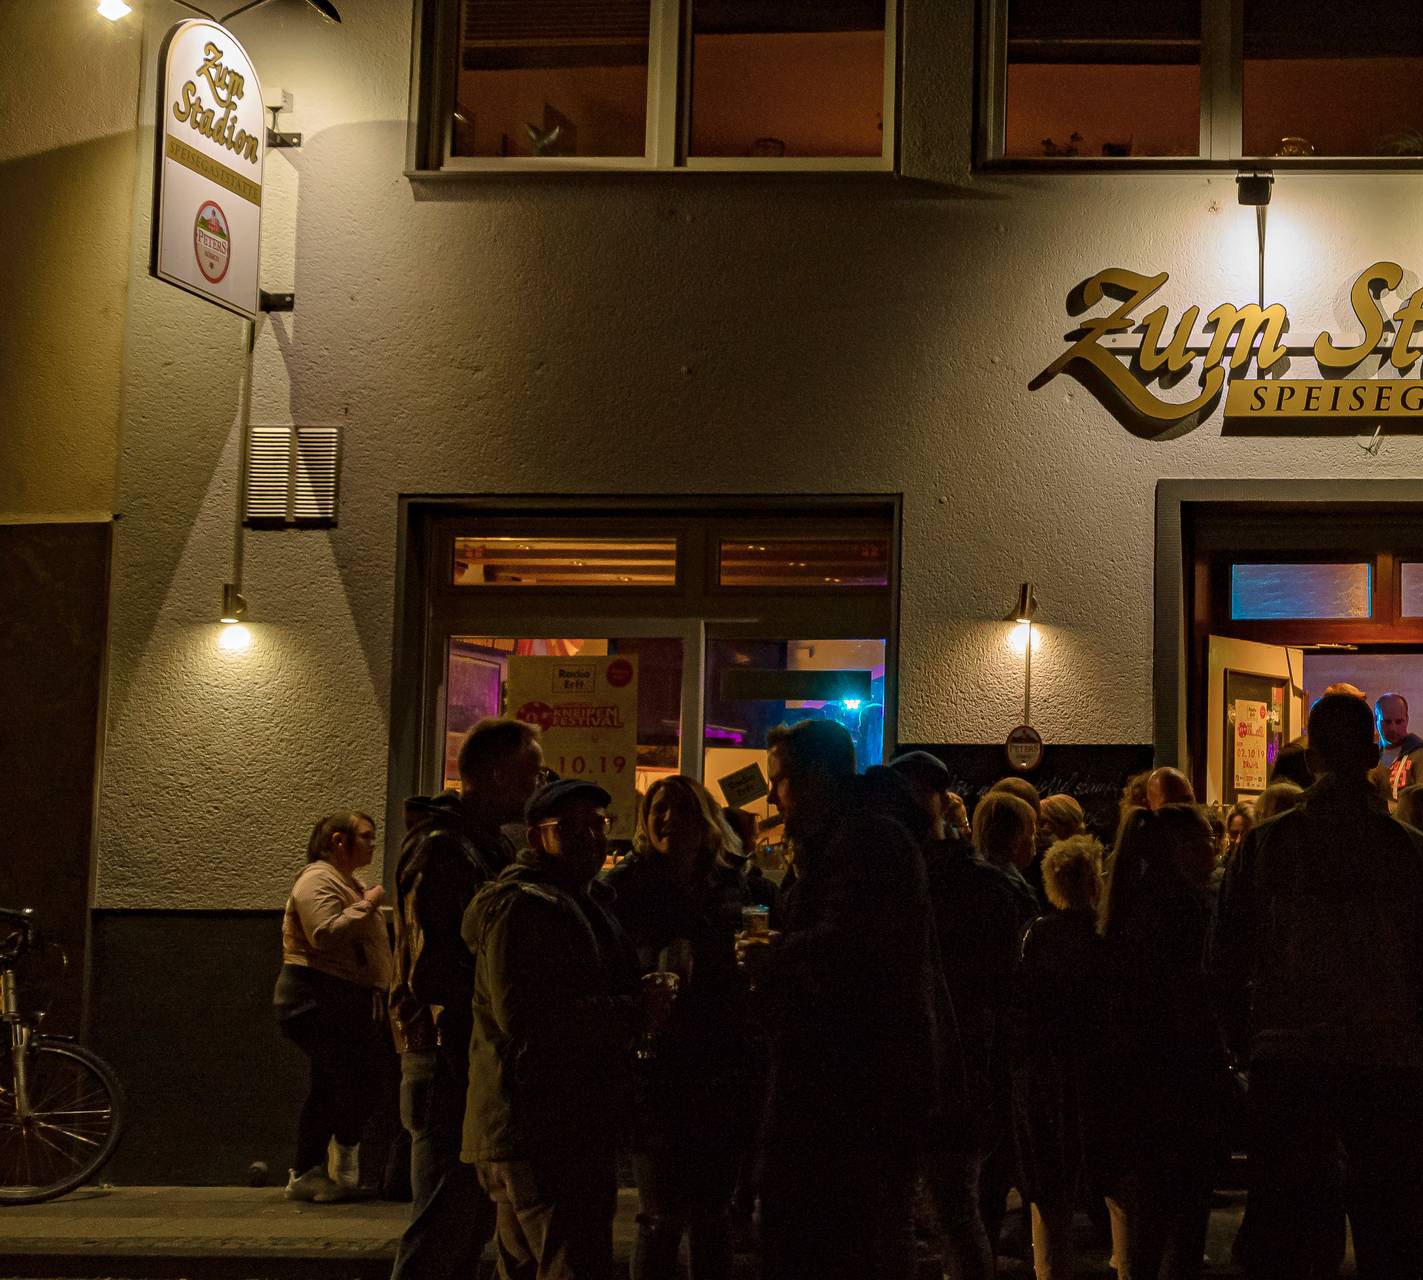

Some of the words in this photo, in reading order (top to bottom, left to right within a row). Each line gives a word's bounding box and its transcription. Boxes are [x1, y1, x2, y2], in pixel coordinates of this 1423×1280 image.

[196, 41, 244, 108] Zum
[173, 80, 258, 164] Stadion
[198, 229, 227, 254] PETERS
[1028, 268, 1288, 420] Zum
[560, 755, 626, 774] 10.19
